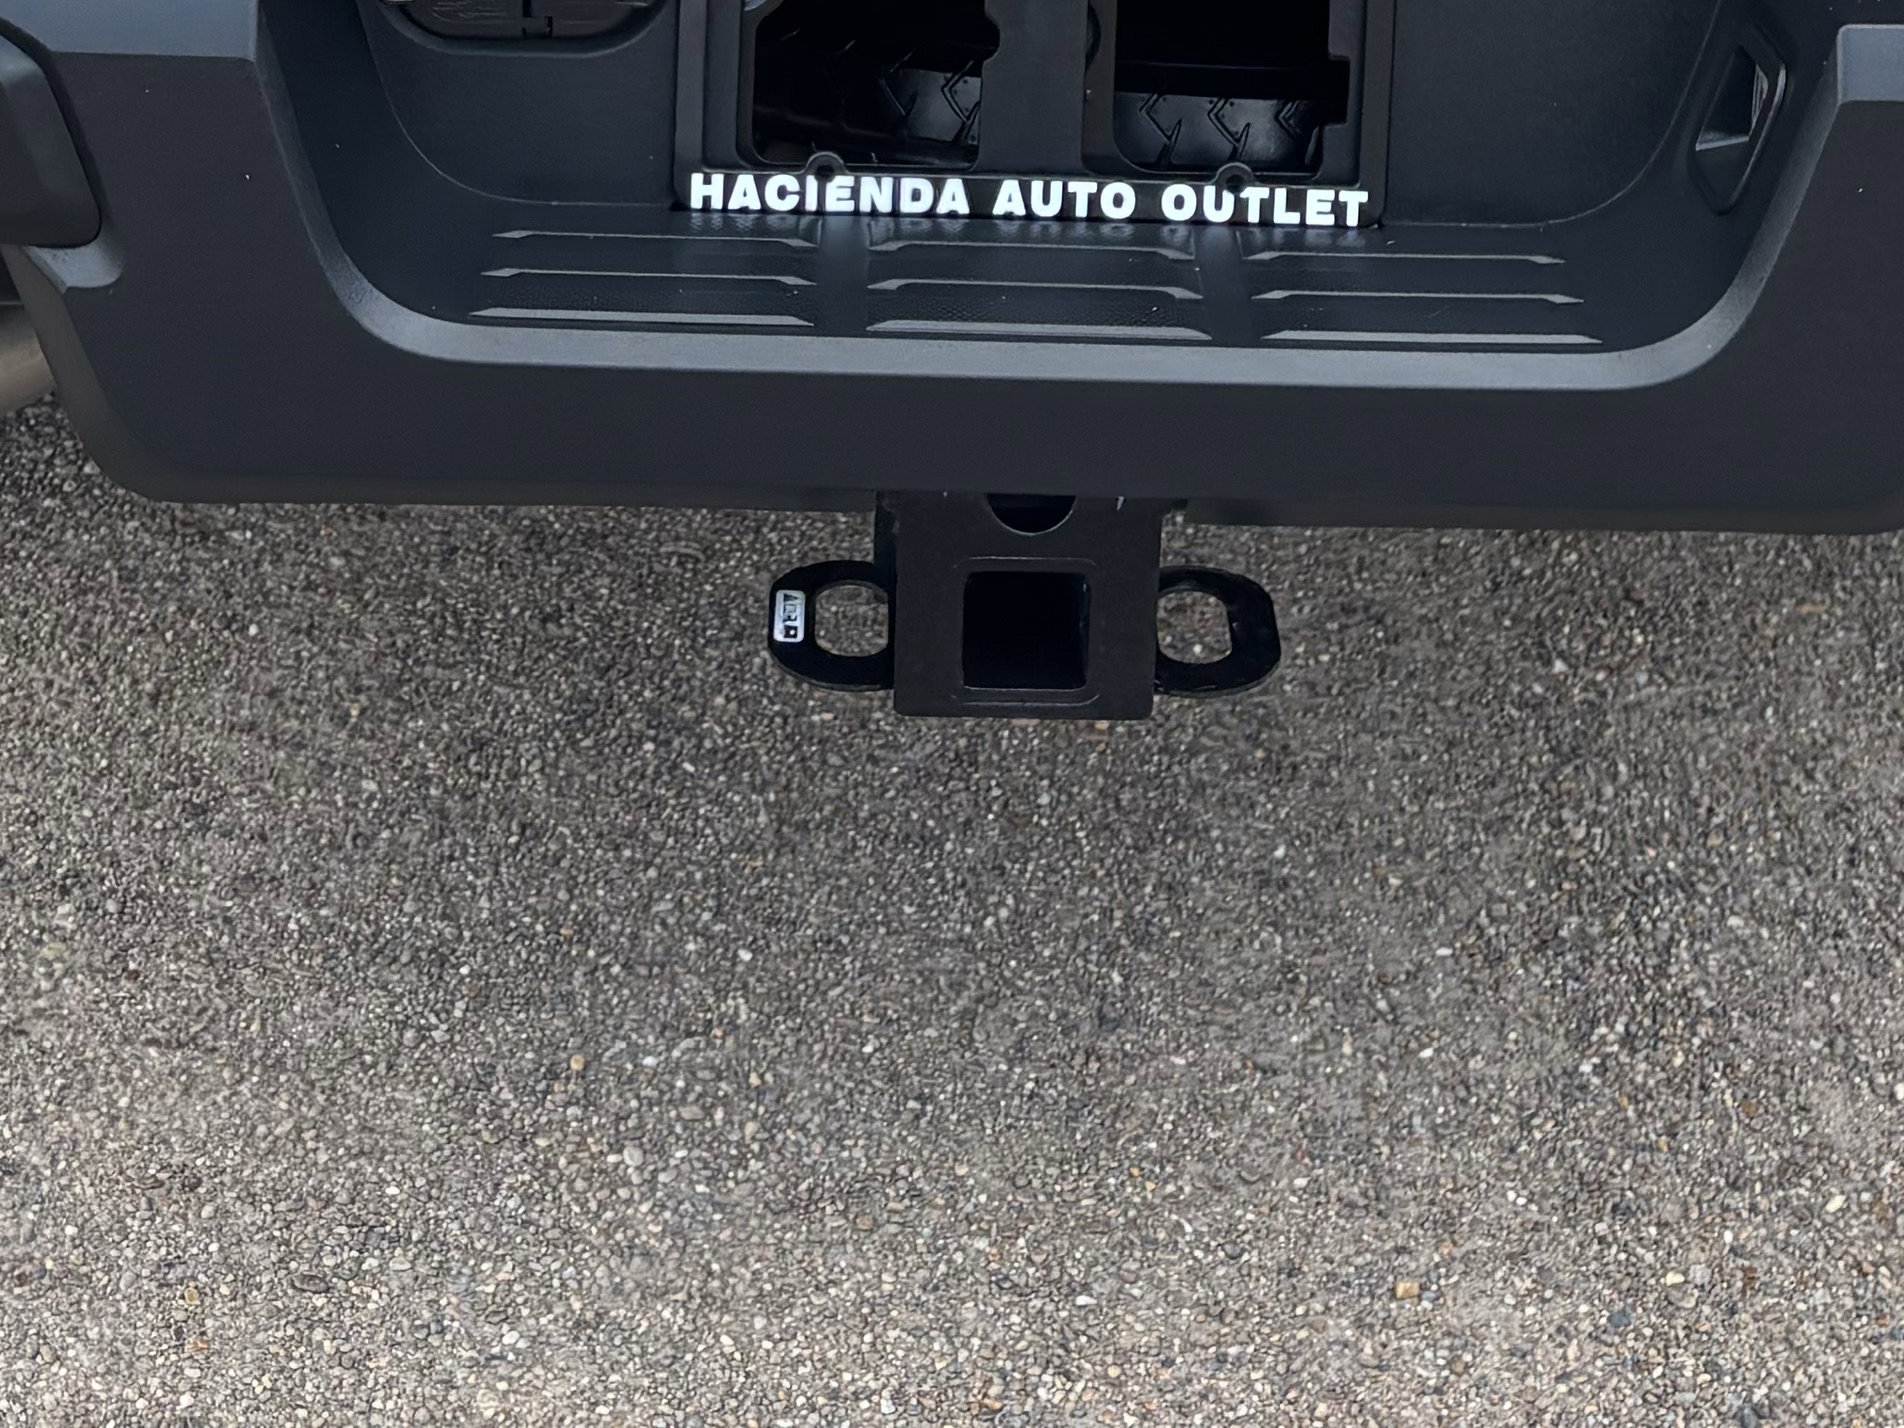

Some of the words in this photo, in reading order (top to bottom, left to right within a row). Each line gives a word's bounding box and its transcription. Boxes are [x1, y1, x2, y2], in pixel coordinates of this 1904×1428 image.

[690, 172, 970, 215] HACIENDA
[992, 179, 1137, 219] AUTO
[1160, 183, 1369, 228] OUTLET
